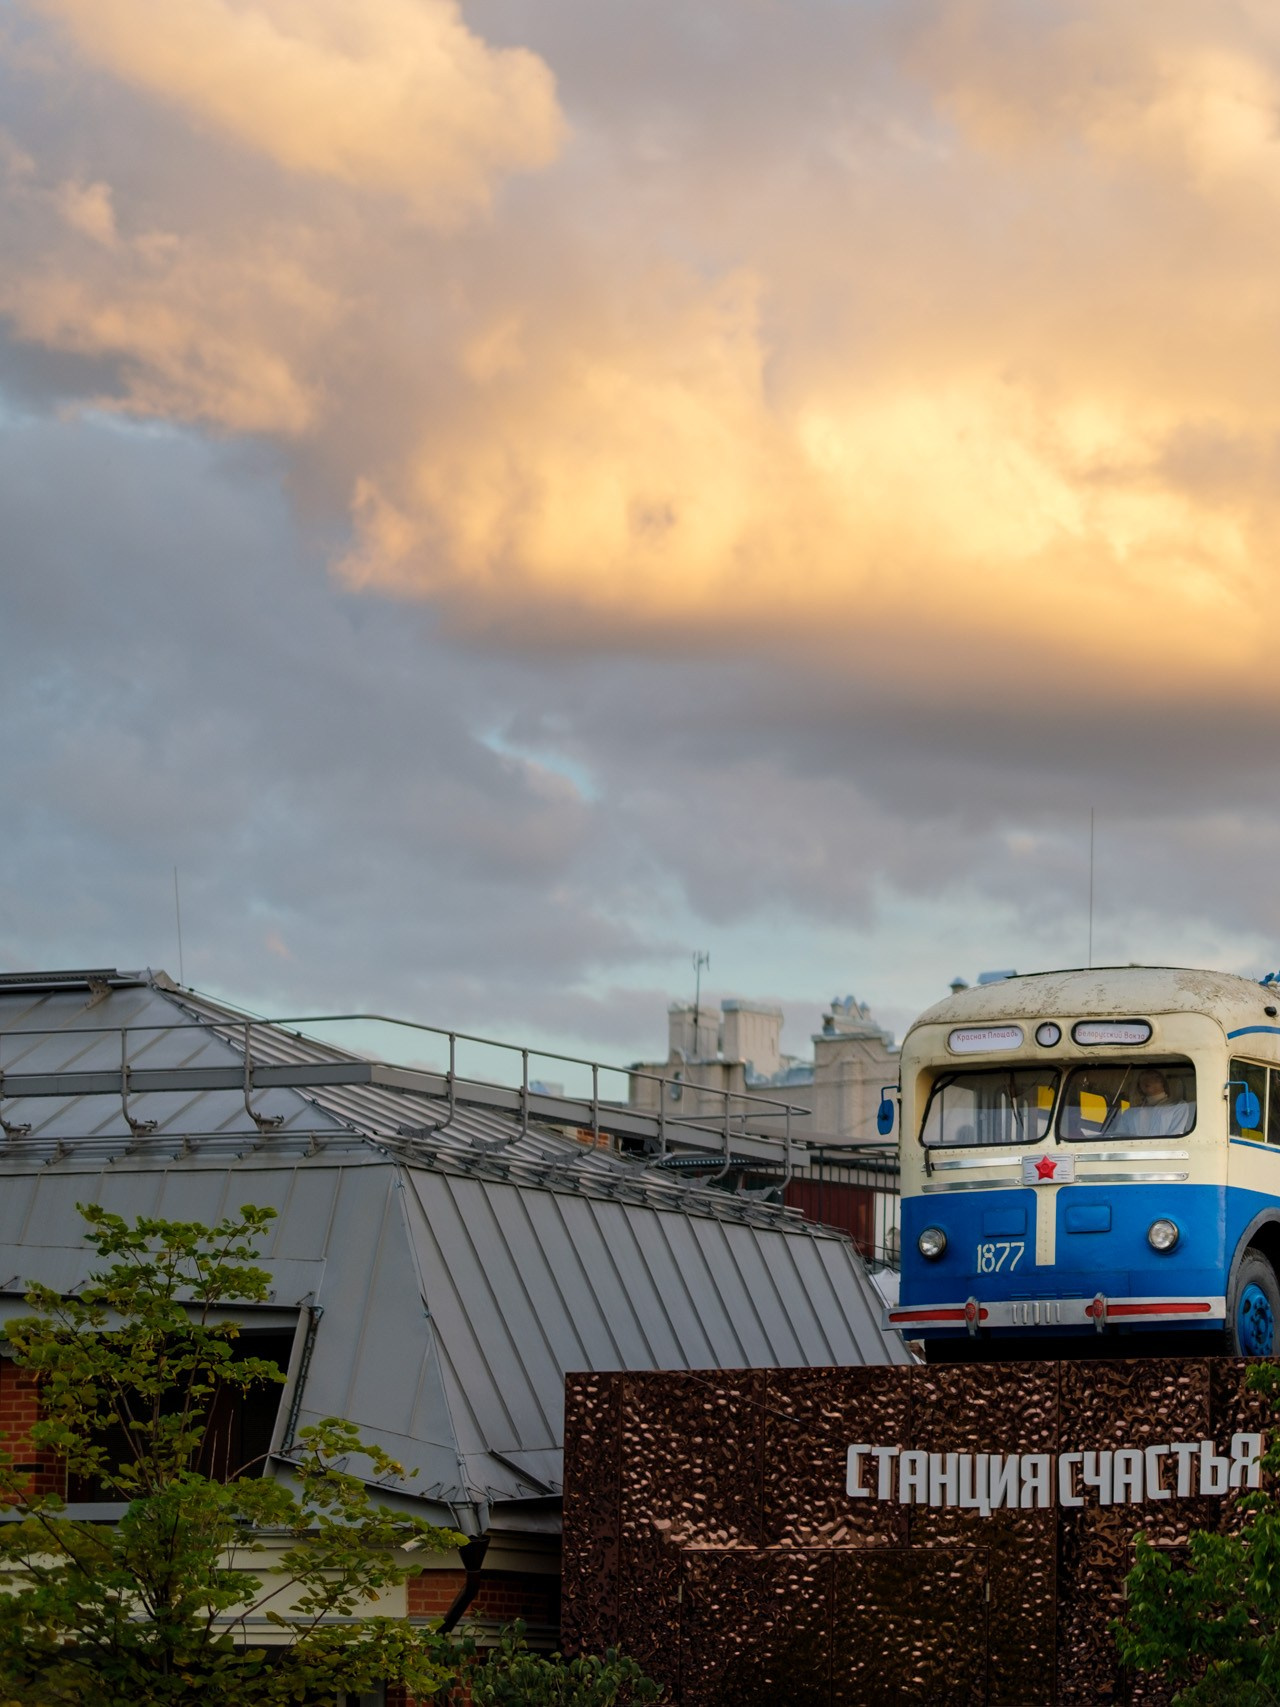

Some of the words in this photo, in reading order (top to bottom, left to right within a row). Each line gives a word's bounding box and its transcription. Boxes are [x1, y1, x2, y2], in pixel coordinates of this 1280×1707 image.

[956, 1033, 987, 1042] Красная
[988, 1029, 1018, 1039] Площадь
[1047, 1028, 1052, 1038] 1
[976, 1241, 1025, 1273] 1877
[846, 1443, 1052, 1517] СТАНЦИЯ
[1058, 1432, 1264, 1507] СЧАСТЬЯ
